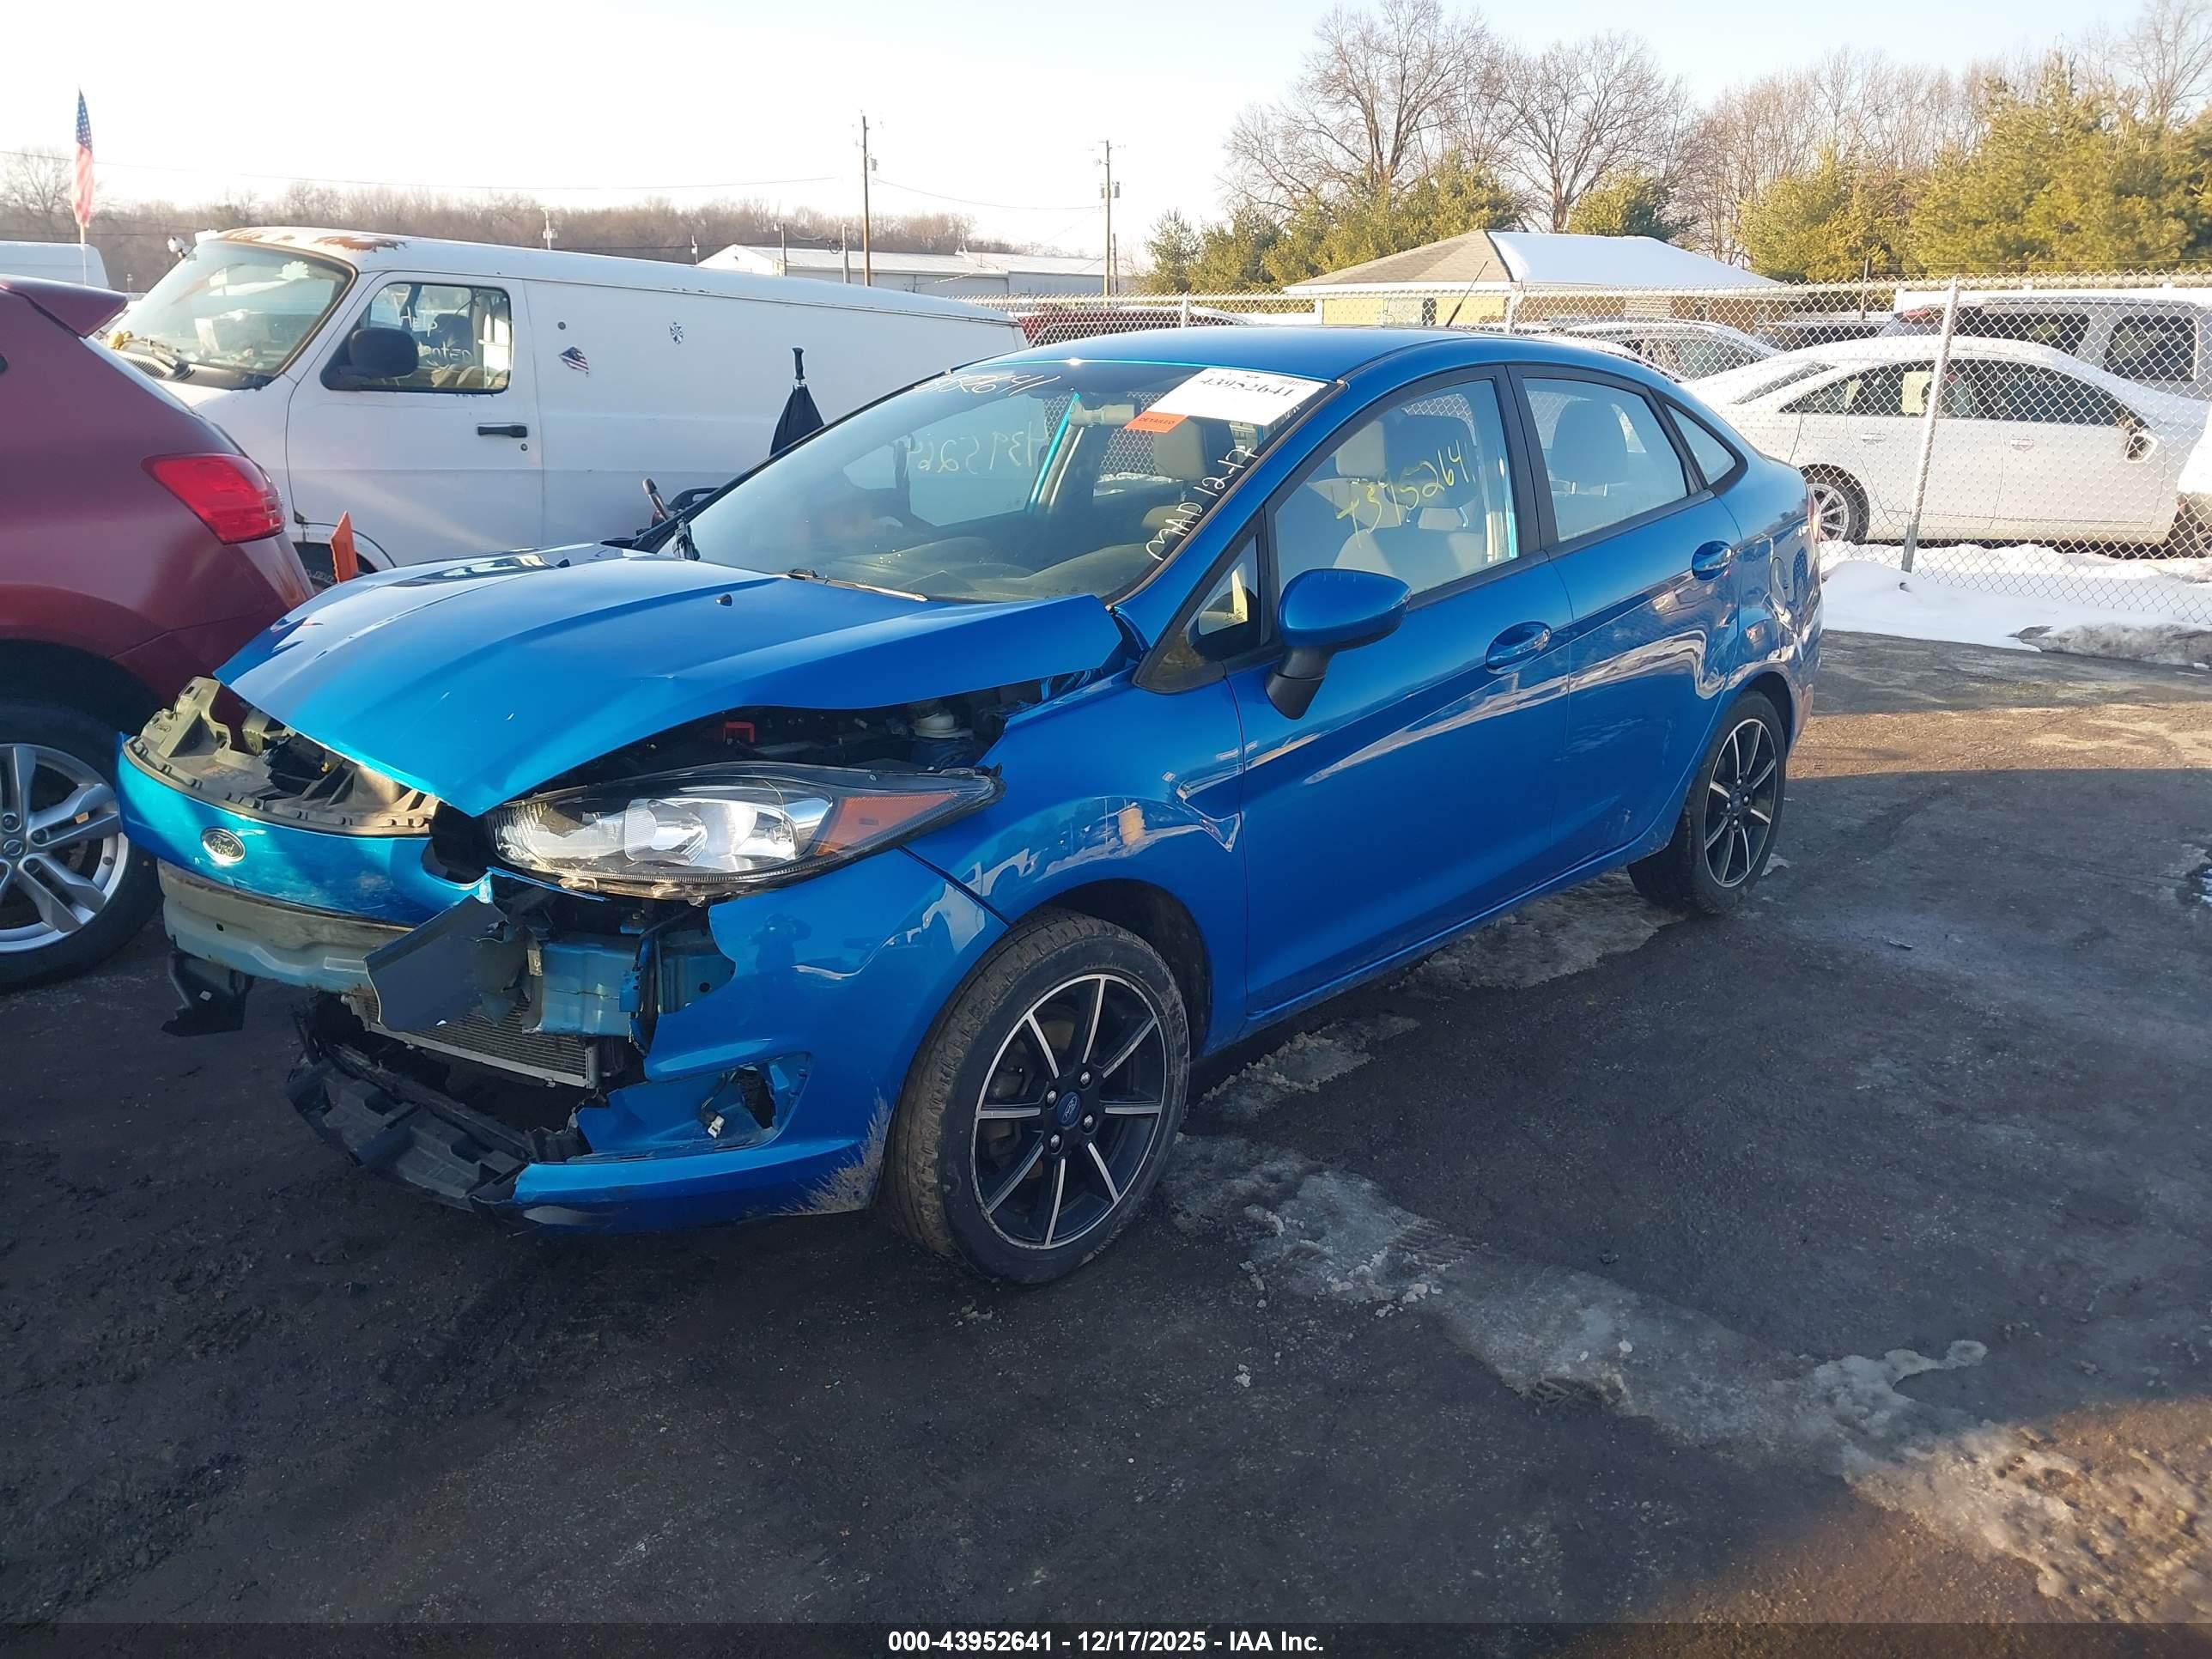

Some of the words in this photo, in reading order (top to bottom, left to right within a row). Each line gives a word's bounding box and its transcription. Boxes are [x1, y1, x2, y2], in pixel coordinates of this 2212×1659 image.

[1145, 501, 1203, 562] MAD
[1194, 447, 1260, 497] 12-17
[210, 835, 235, 857] Ford
